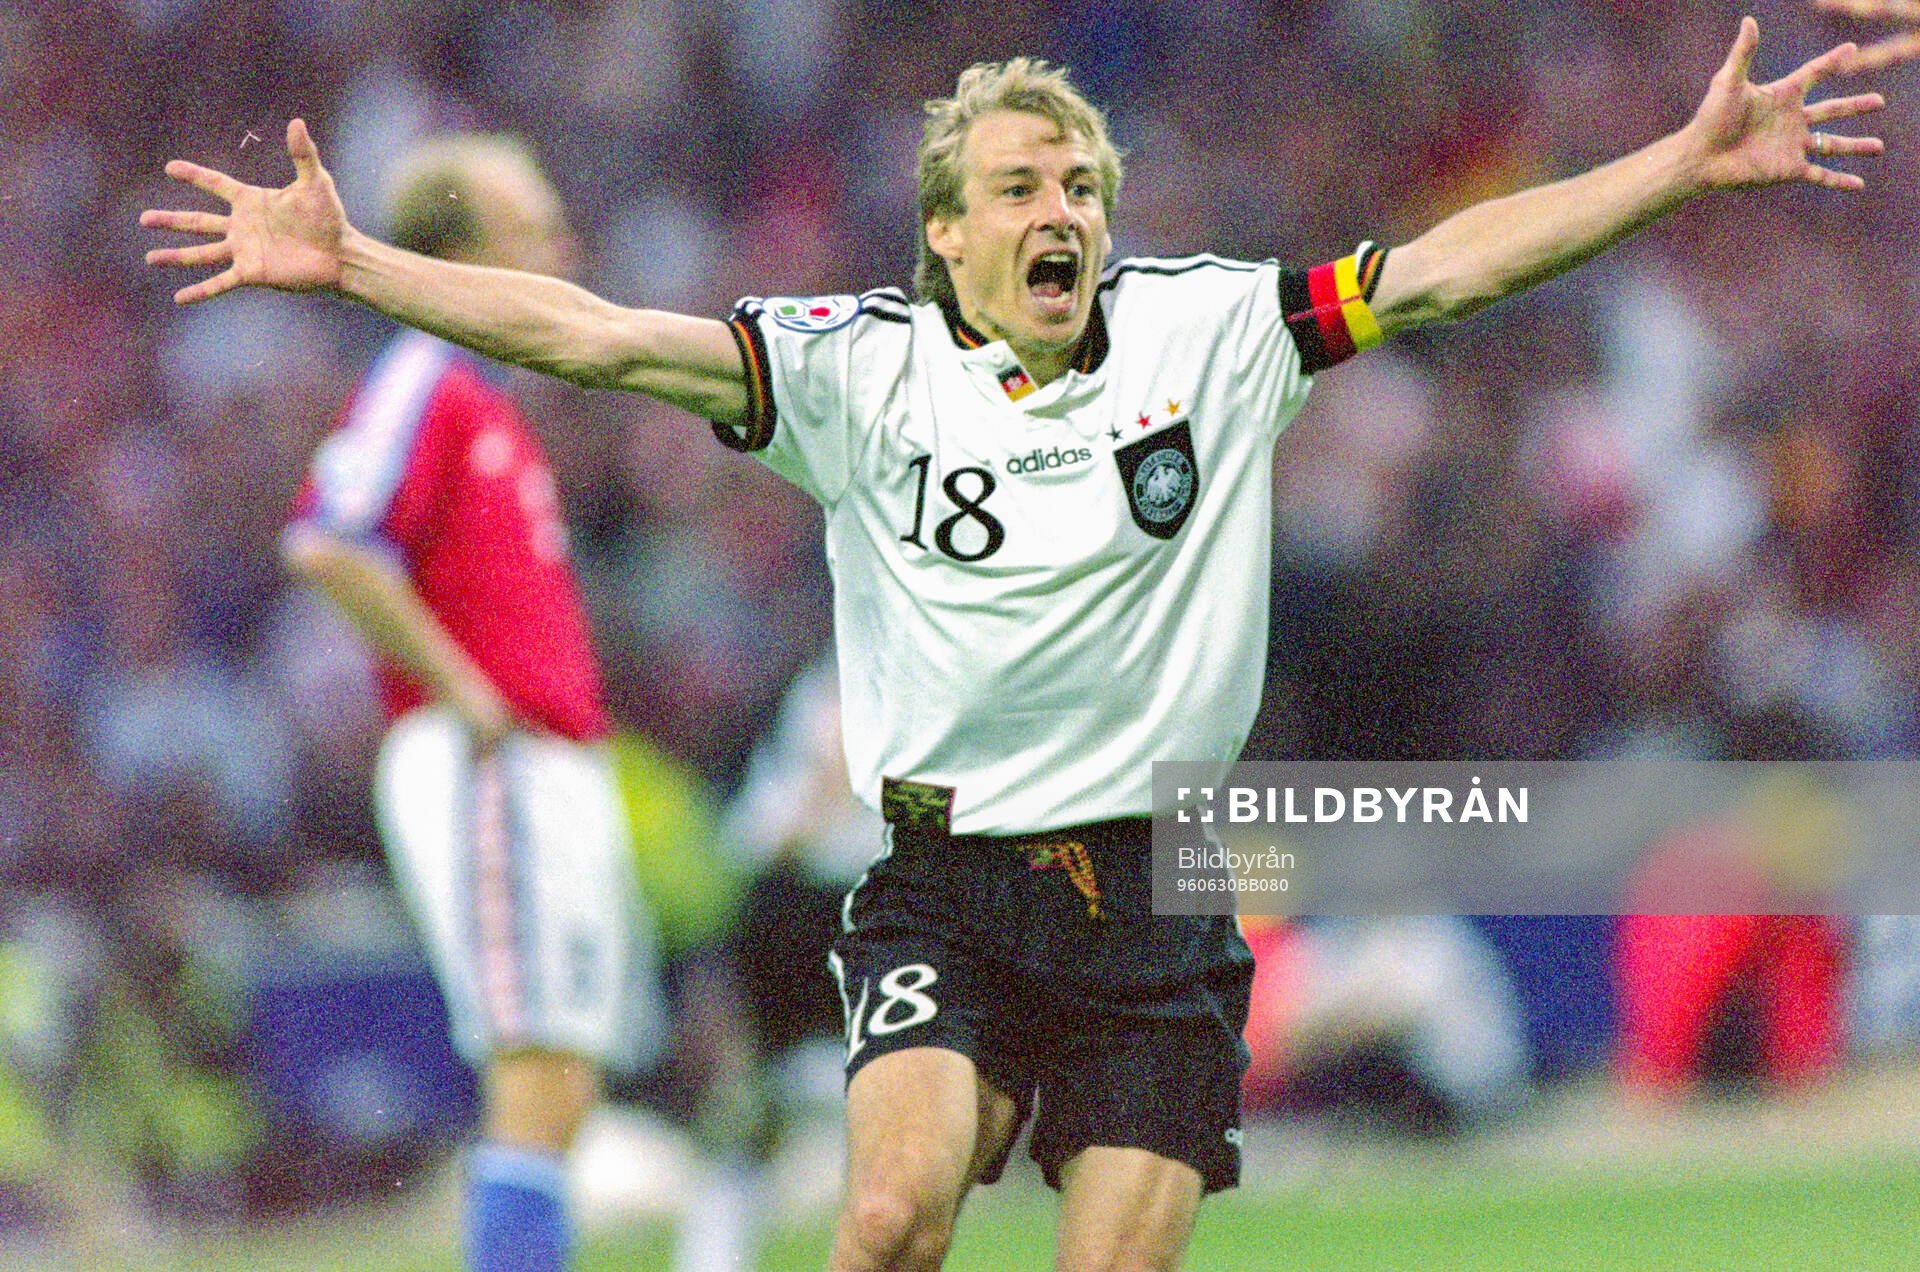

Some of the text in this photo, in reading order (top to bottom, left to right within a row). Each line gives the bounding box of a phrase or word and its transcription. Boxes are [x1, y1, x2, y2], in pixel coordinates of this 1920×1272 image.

[900, 453, 1006, 562] 18
[1006, 446, 1092, 475] adidas
[846, 963, 938, 1064] 18
